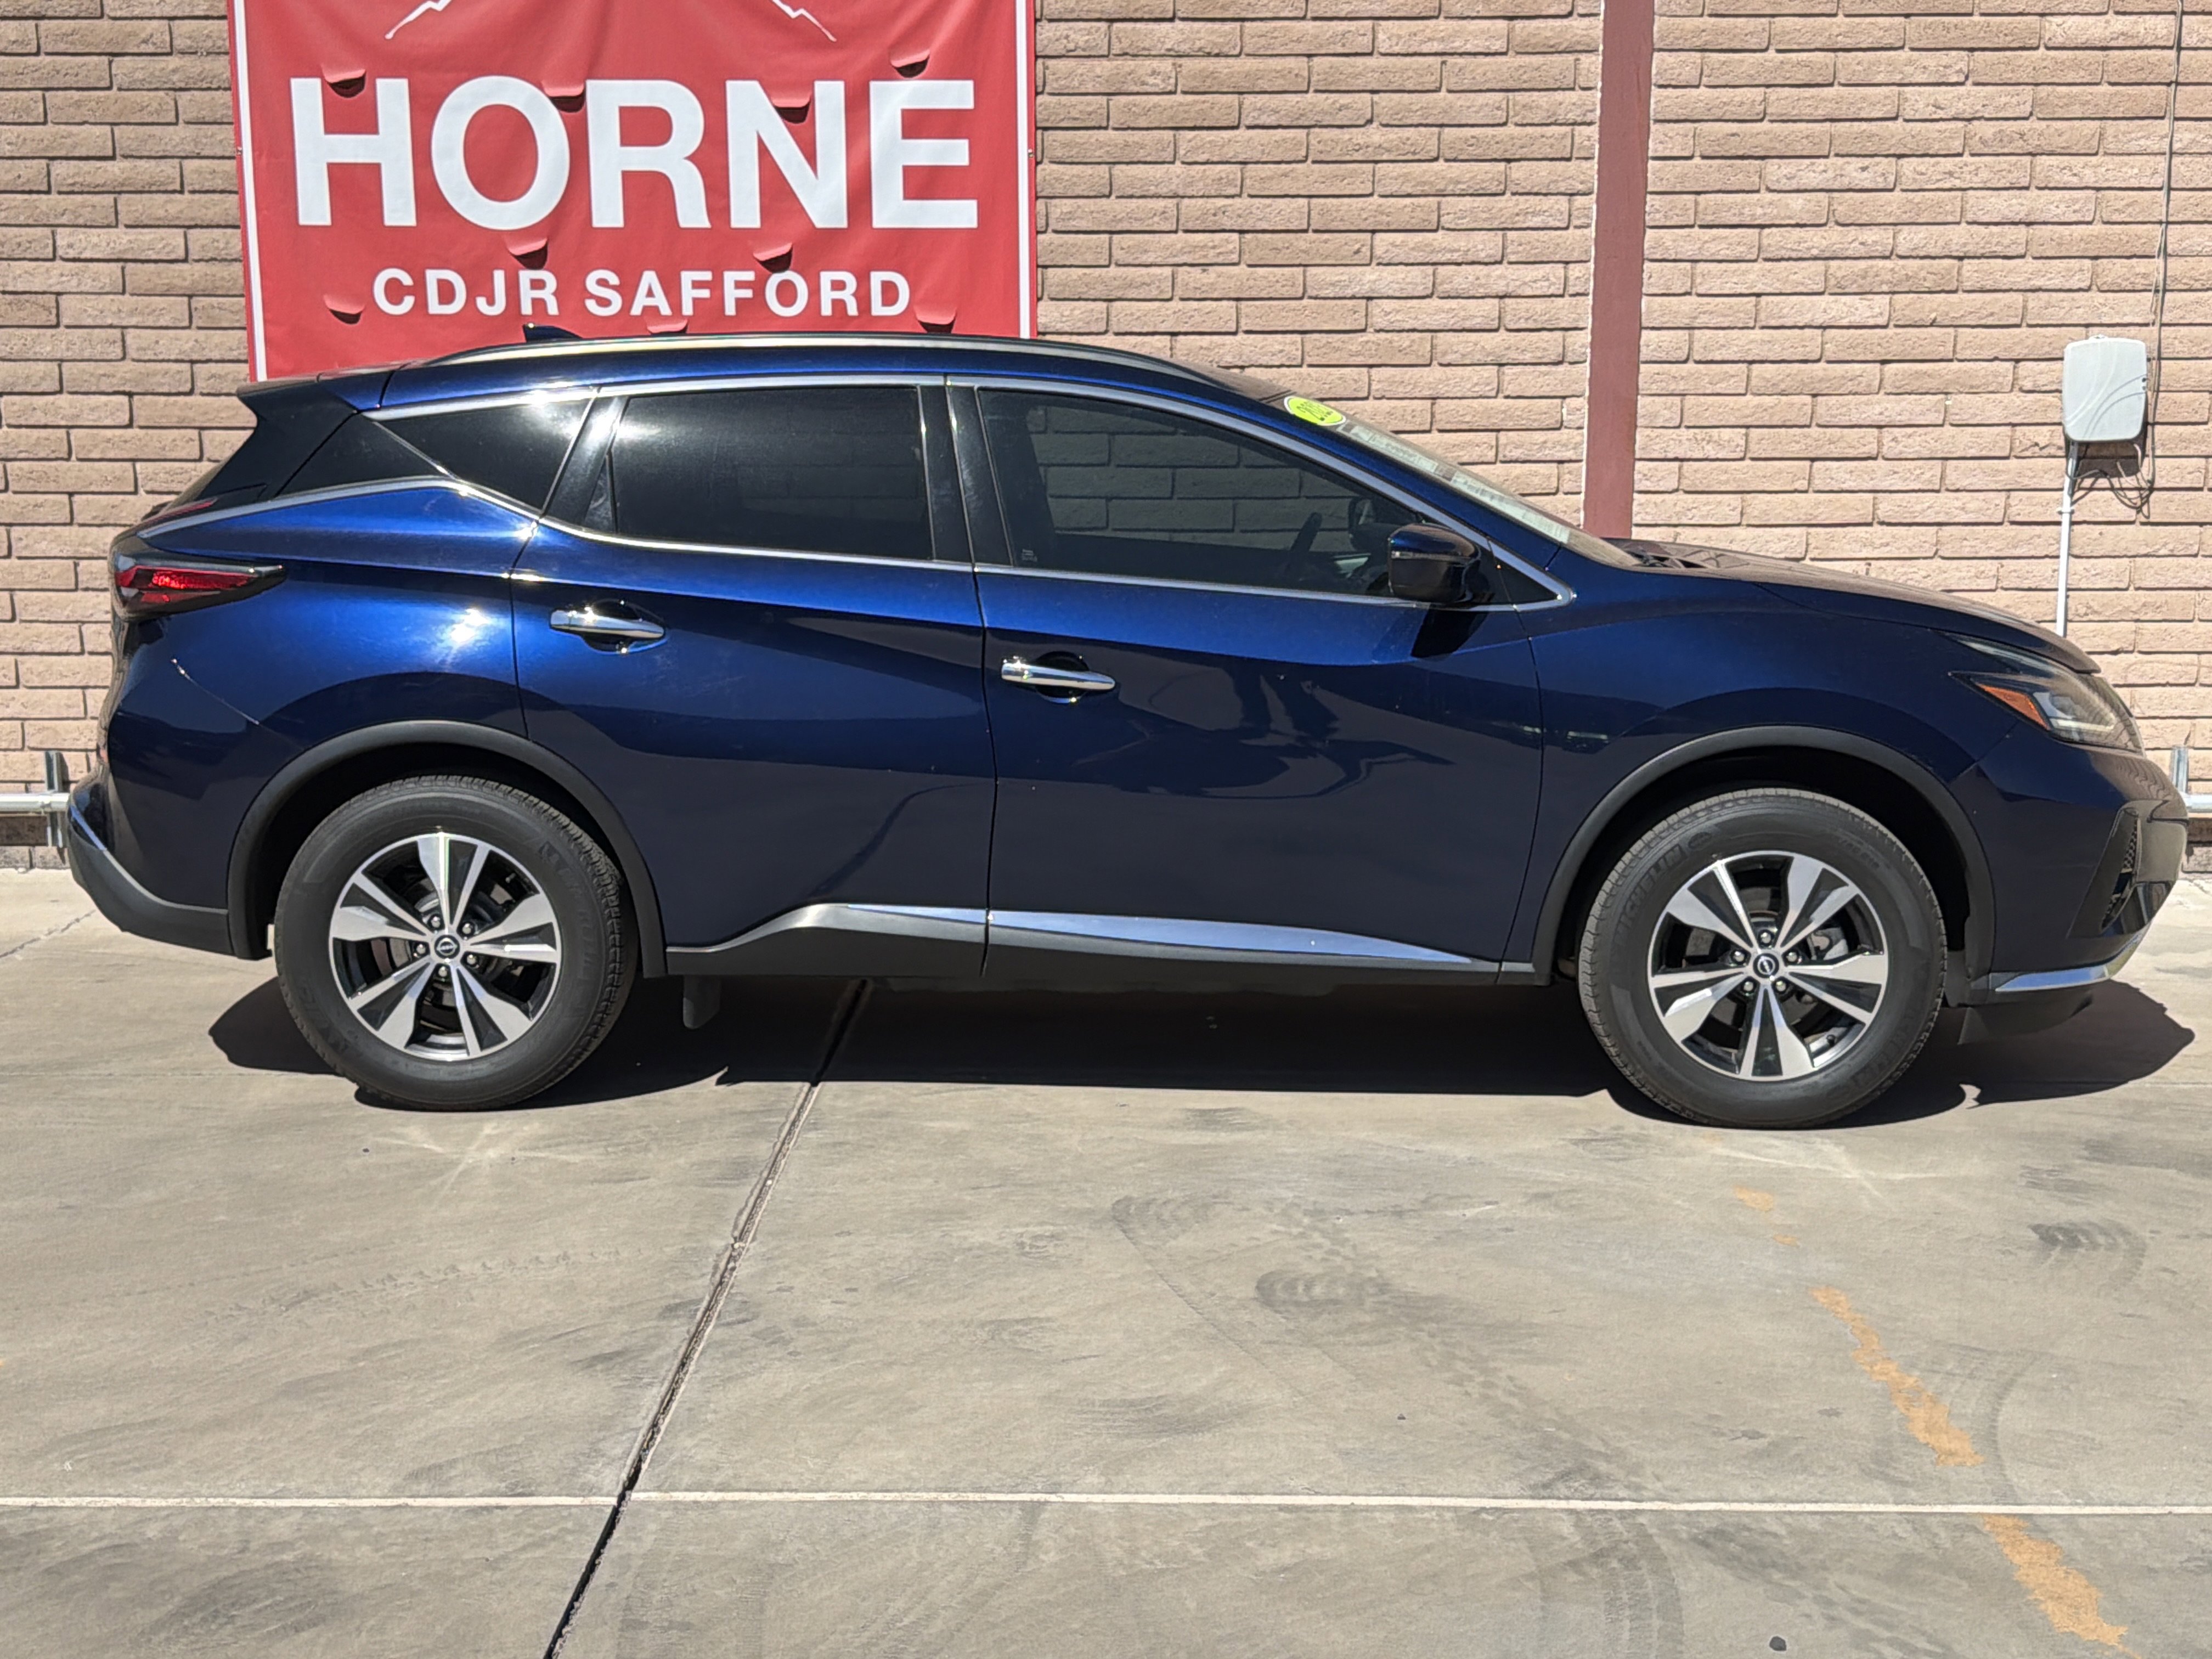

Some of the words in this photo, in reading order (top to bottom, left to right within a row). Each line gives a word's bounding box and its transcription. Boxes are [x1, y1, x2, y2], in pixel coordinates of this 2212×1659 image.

[290, 75, 978, 231] HORNE
[373, 268, 559, 316] CDJR
[584, 269, 910, 317] SAFFORD
